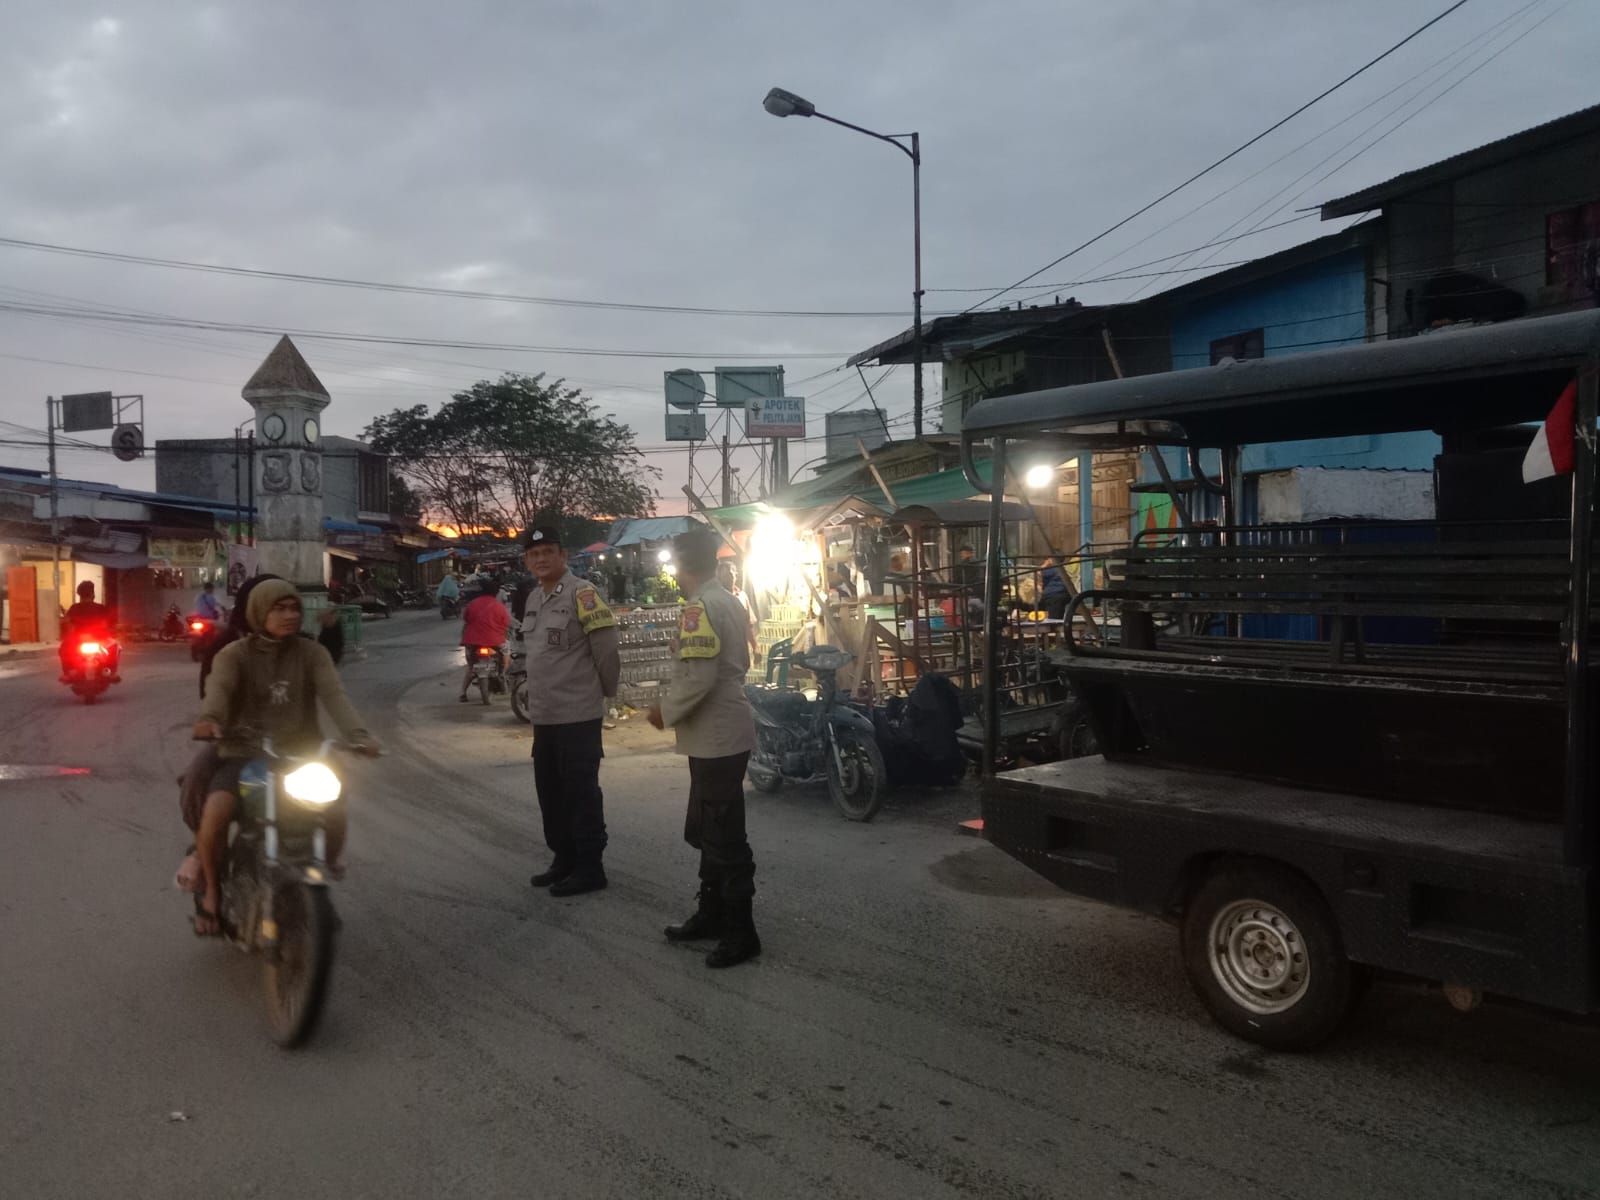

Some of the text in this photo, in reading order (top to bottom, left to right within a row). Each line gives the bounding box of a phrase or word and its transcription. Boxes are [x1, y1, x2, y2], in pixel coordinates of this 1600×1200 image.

[764, 399, 800, 410] APOTEK
[763, 413, 801, 423] PELITA JAYA
